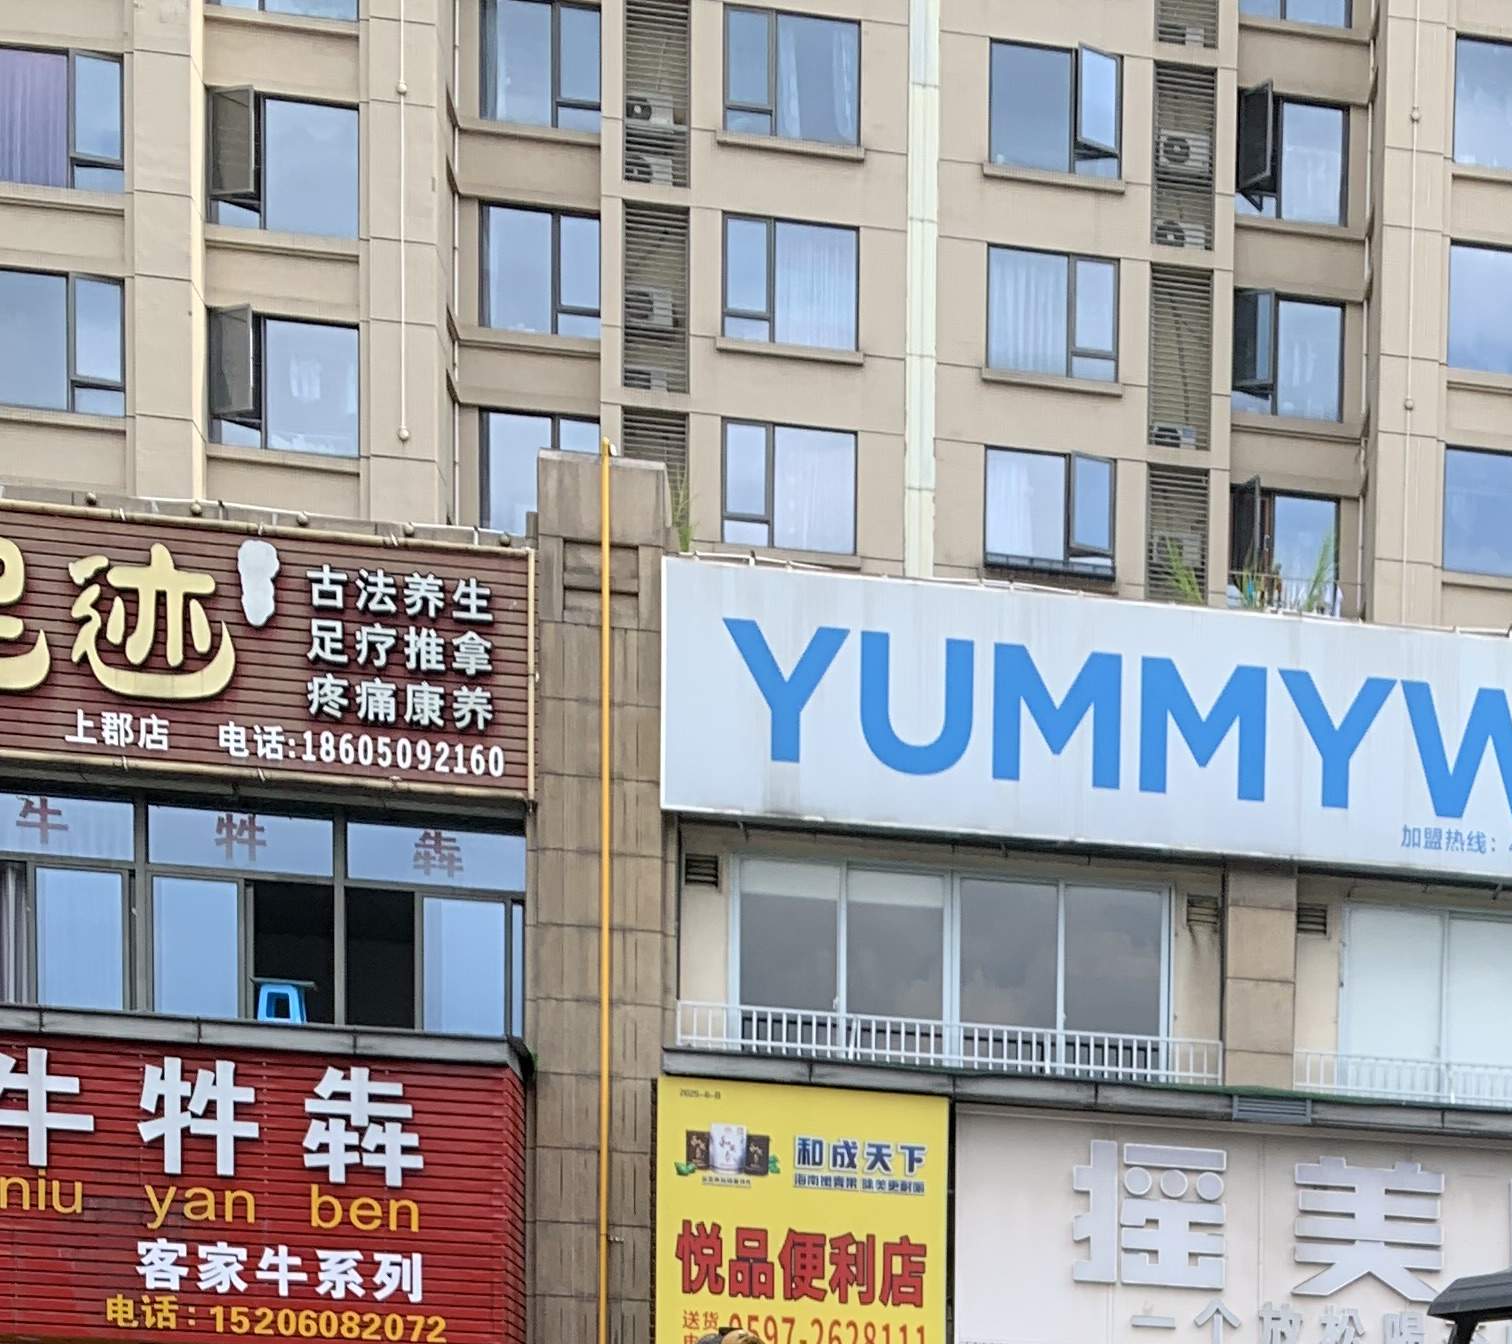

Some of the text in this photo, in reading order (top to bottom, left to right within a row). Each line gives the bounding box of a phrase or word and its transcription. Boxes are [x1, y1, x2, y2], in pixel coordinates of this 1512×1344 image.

[307, 564, 493, 622] 古法养生
[307, 619, 493, 676] 足疗推拿
[65, 709, 169, 750] 上郡店
[307, 673, 494, 730] 疼痛康养
[796, 1136, 926, 1174] 和成天下
[0, 1170, 419, 1232] niu yan ben
[136, 1238, 423, 1302] 客家牛系列
[675, 1219, 927, 1308] 悦品便利店
